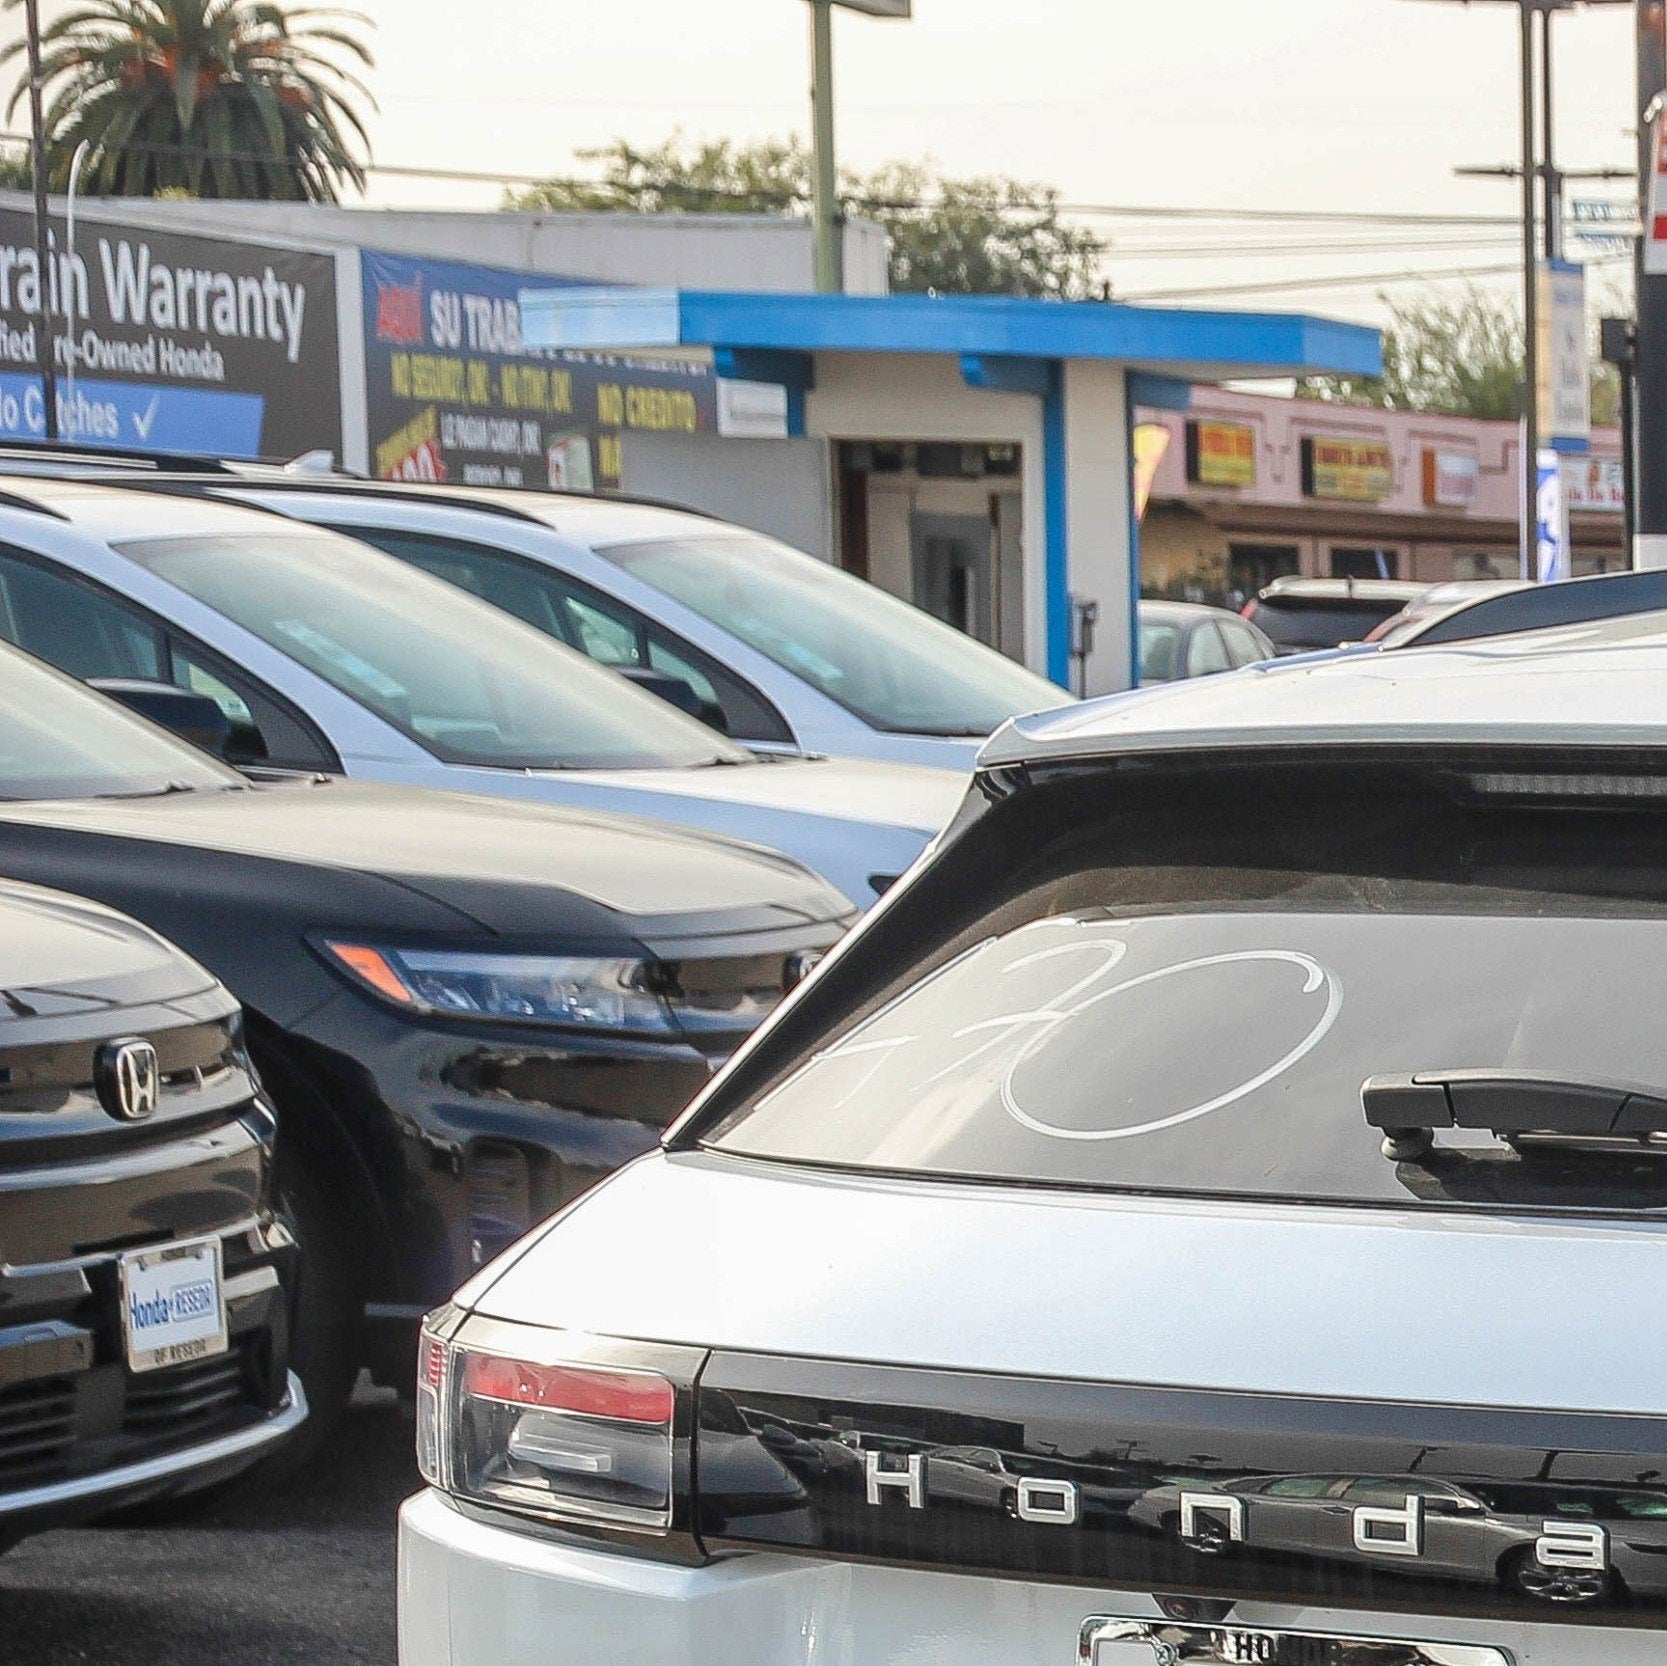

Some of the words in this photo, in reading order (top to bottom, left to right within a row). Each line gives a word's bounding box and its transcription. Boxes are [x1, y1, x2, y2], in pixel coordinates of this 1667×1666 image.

[99, 238, 305, 363] Warranty
[53, 329, 156, 375] re-Owned
[159, 336, 226, 381] Honda
[24, 383, 119, 439] Ctches
